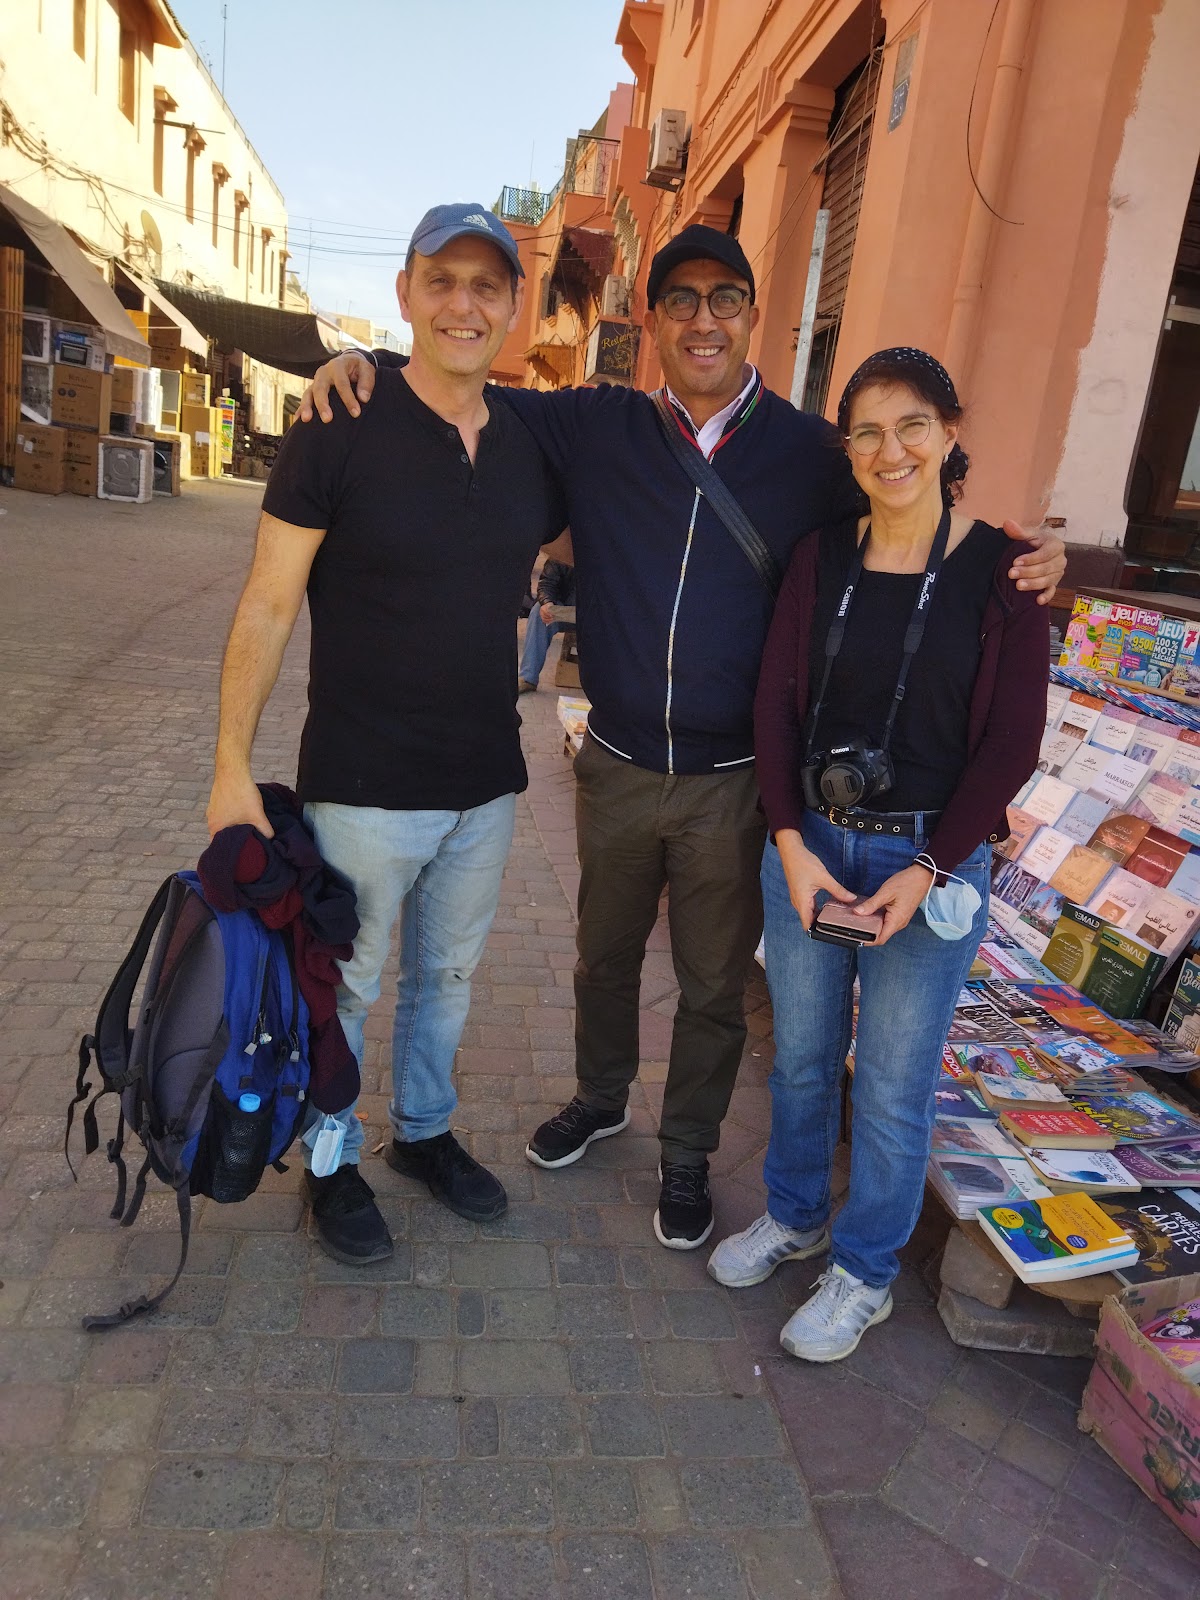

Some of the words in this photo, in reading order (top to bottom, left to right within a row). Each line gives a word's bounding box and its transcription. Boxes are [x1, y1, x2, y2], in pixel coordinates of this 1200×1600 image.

[917, 571, 936, 610] PowerShot
[837, 585, 854, 617] Canon
[1067, 623, 1085, 638] 290
[1106, 626, 1123, 640] 350
[1156, 637, 1171, 647] 100
[1171, 641, 1179, 650] %
[1184, 630, 1198, 649] 7
[1153, 645, 1177, 657] MOTS
[830, 746, 850, 755] Canon
[1104, 772, 1135, 789] MARRAKECH
[1022, 1049, 1041, 1071] MOTS
[1138, 1204, 1200, 1256] CARTES
